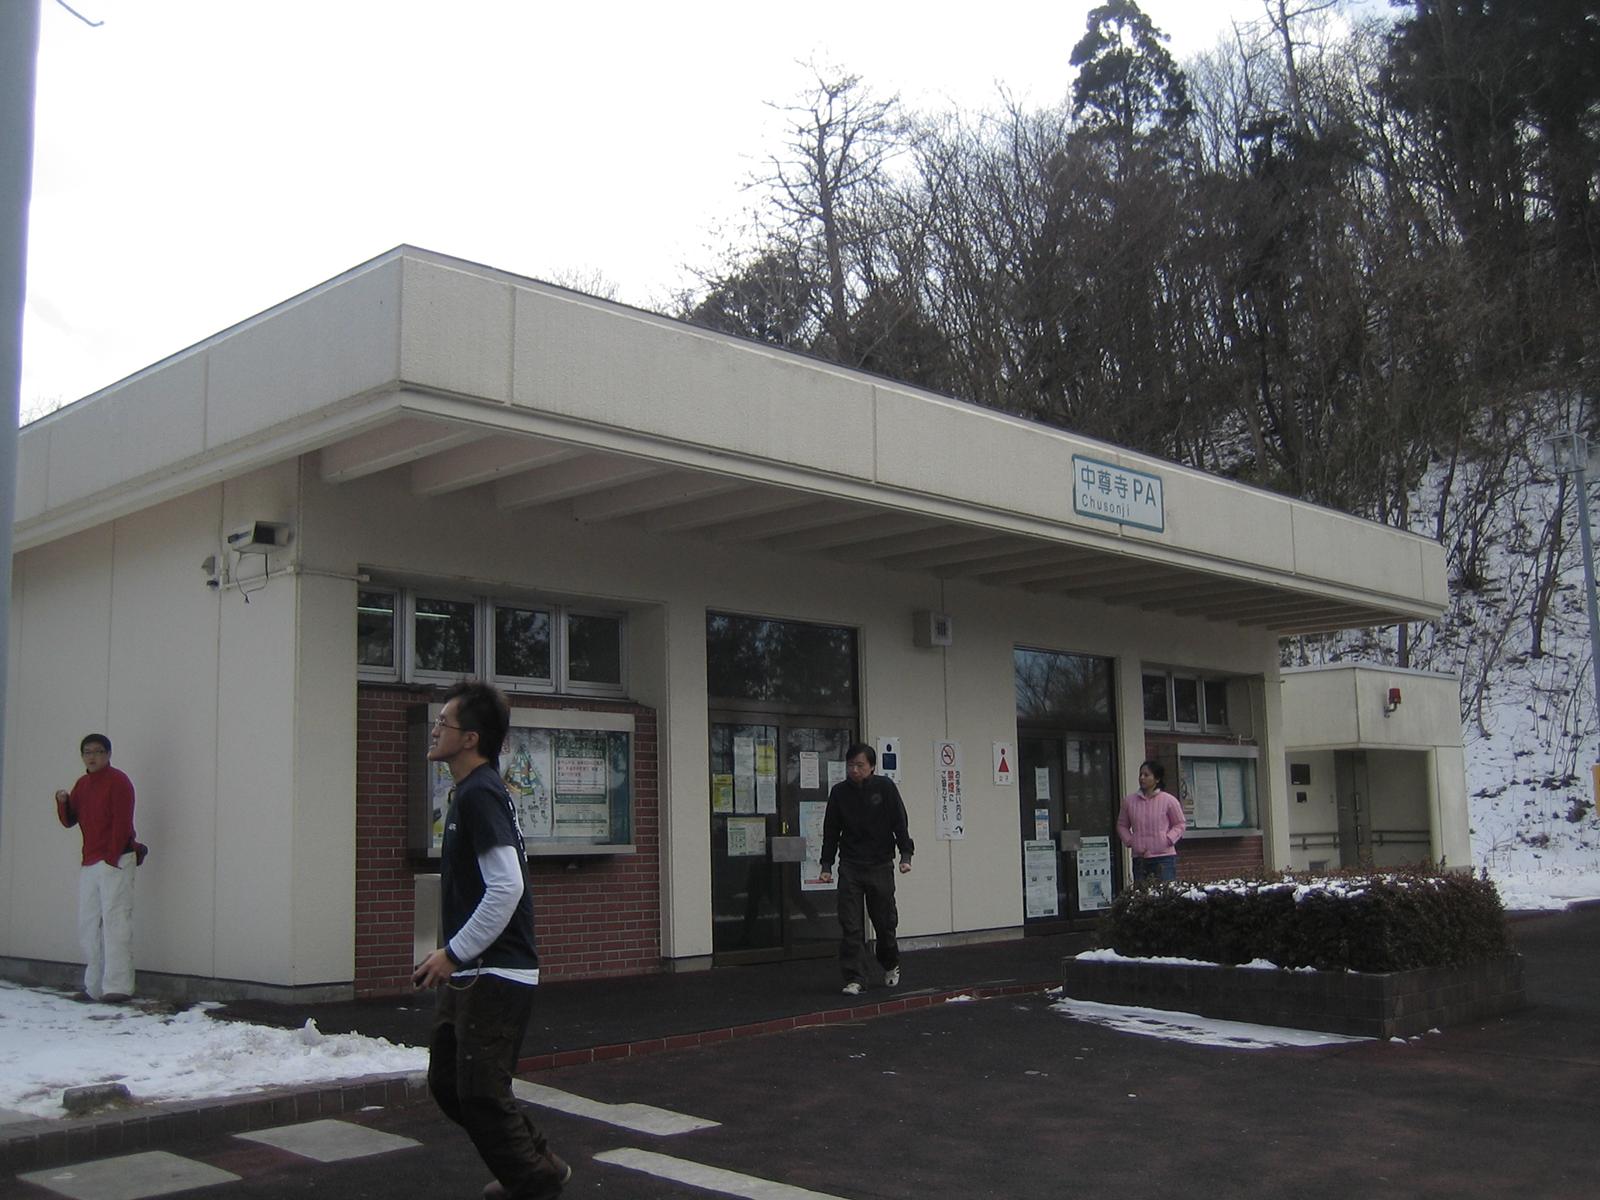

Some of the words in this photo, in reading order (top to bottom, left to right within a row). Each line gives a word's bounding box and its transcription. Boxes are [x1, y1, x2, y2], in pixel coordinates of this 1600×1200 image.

[1081, 465, 1157, 507] 中尊寺PA
[1081, 494, 1130, 518] Chusonji
